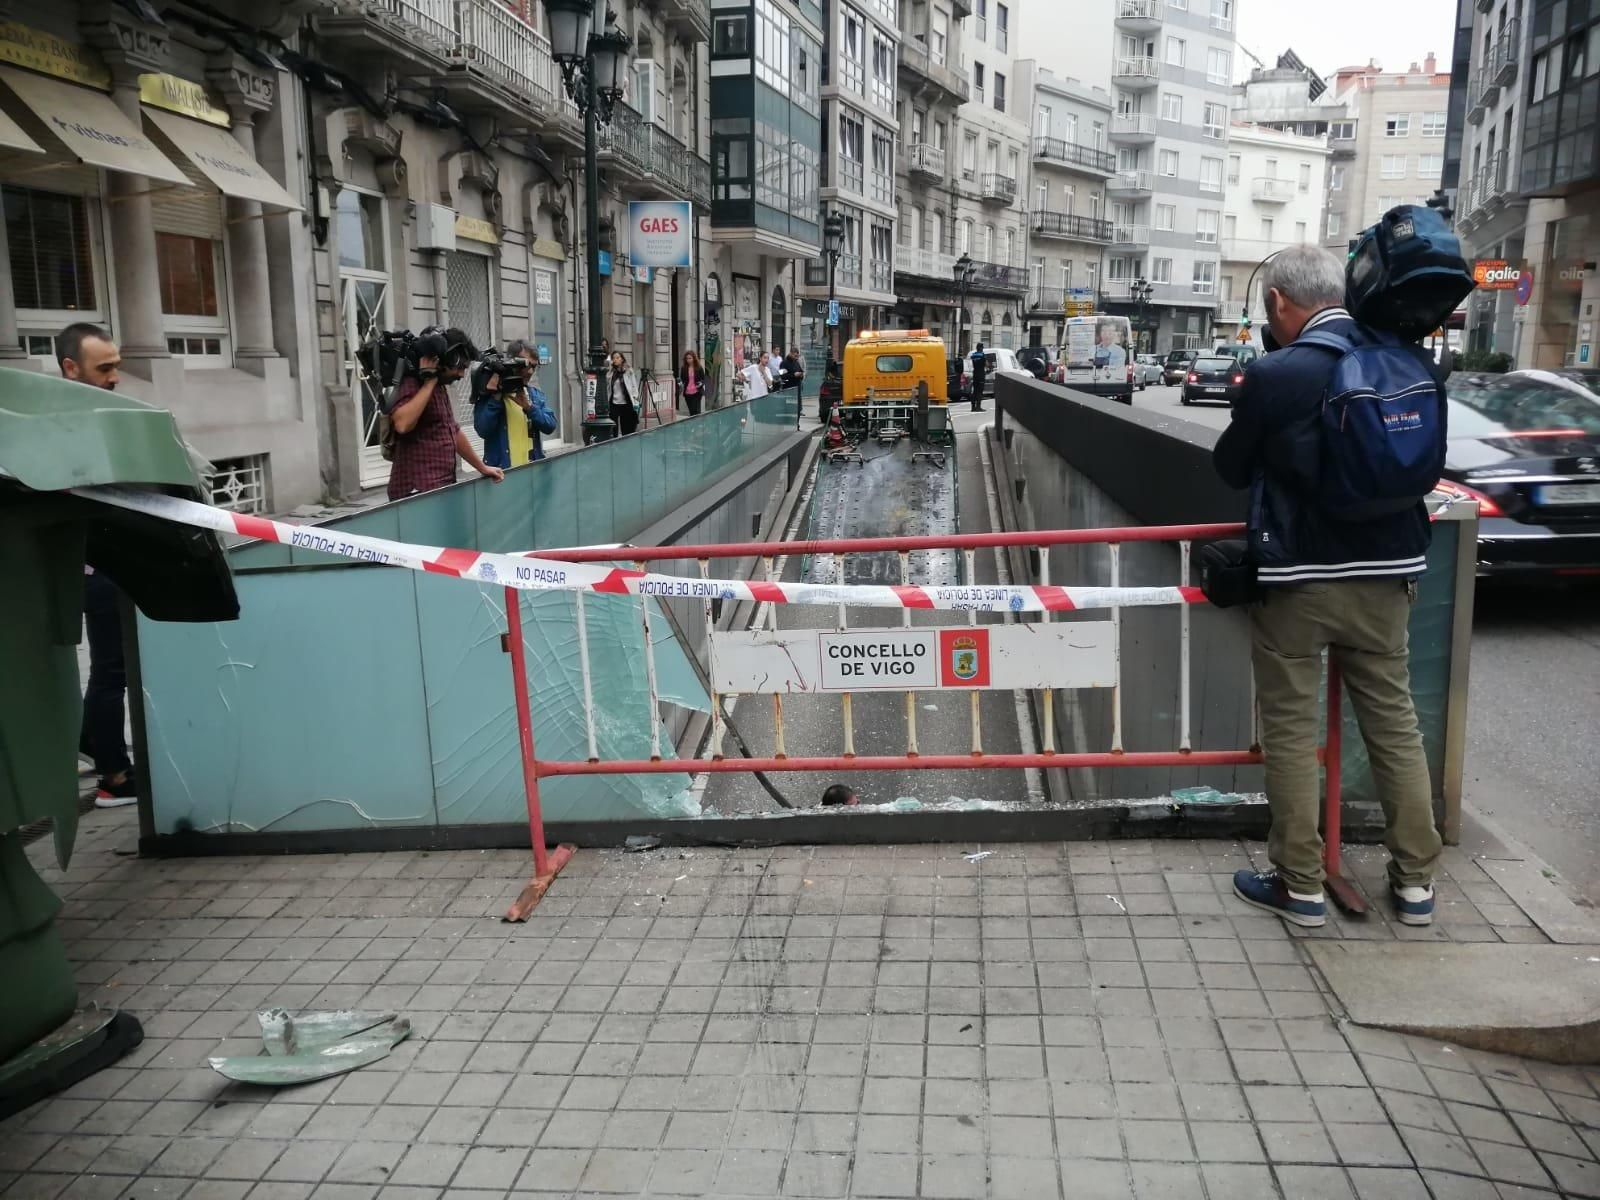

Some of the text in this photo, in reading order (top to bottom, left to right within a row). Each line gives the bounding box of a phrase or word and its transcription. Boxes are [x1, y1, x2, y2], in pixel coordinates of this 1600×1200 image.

[640, 217, 678, 233] GAES
[1486, 266, 1520, 282] galia
[292, 531, 336, 552] POLICIA
[339, 543, 354, 555] DE
[357, 547, 390, 564] LINEA
[516, 566, 566, 584] NO PASAR
[639, 581, 719, 597] LINEA DE POLICIA
[936, 588, 1008, 601] LINEA DE POLICIA
[828, 643, 926, 659] CONCELLO
[840, 661, 915, 676] DE VIGO
